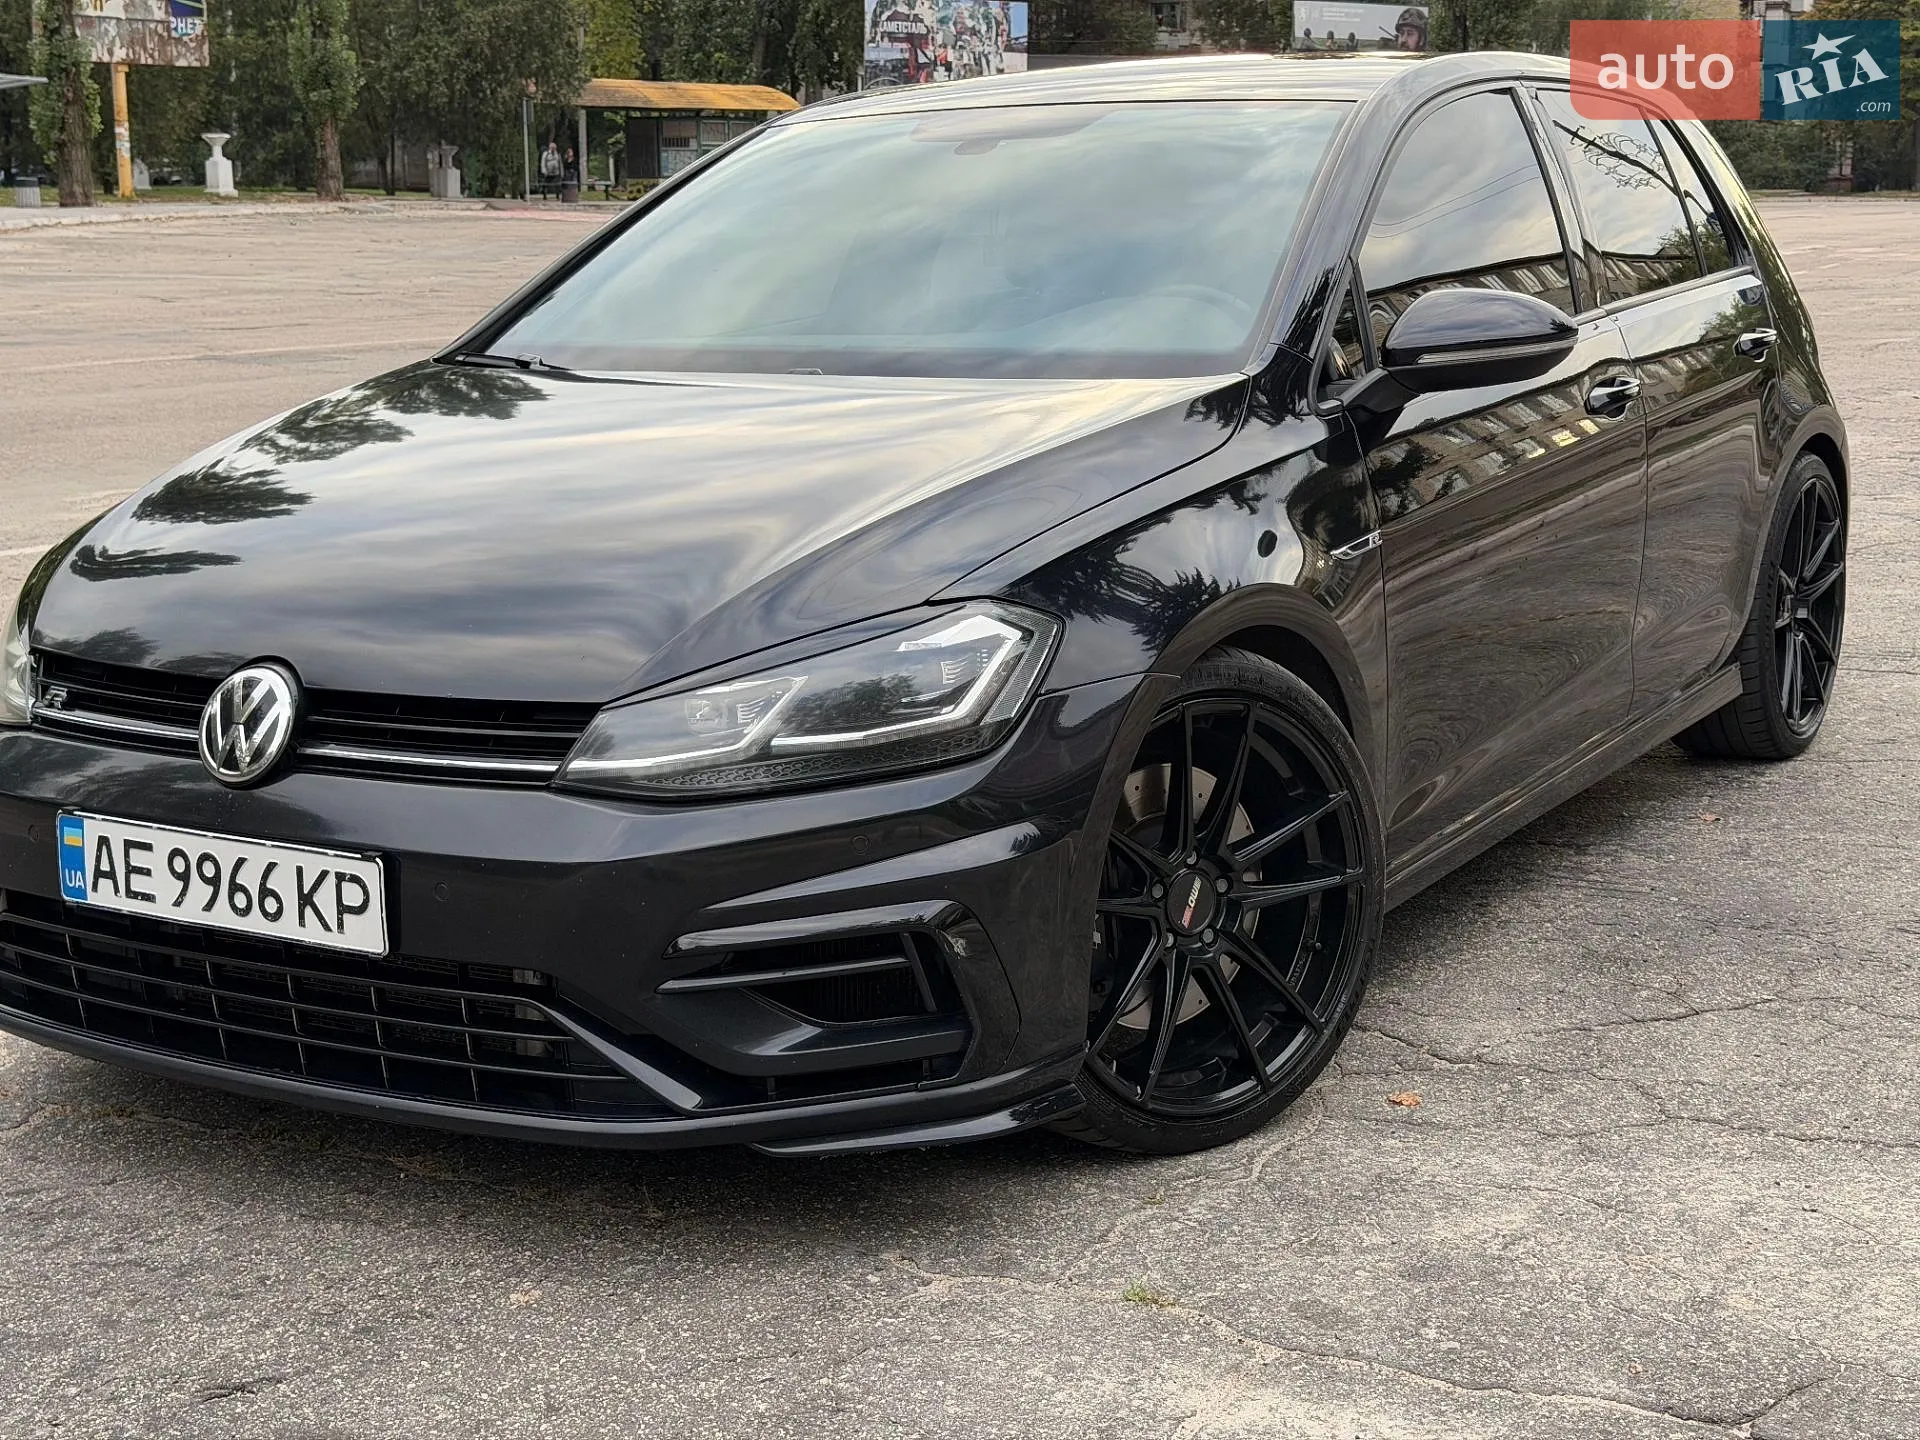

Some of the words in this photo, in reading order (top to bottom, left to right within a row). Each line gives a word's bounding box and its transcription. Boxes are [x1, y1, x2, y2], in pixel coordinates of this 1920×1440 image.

[66, 870, 85, 888] UA
[91, 835, 156, 904] AE
[167, 847, 284, 922] 9966
[296, 864, 371, 935] KP
